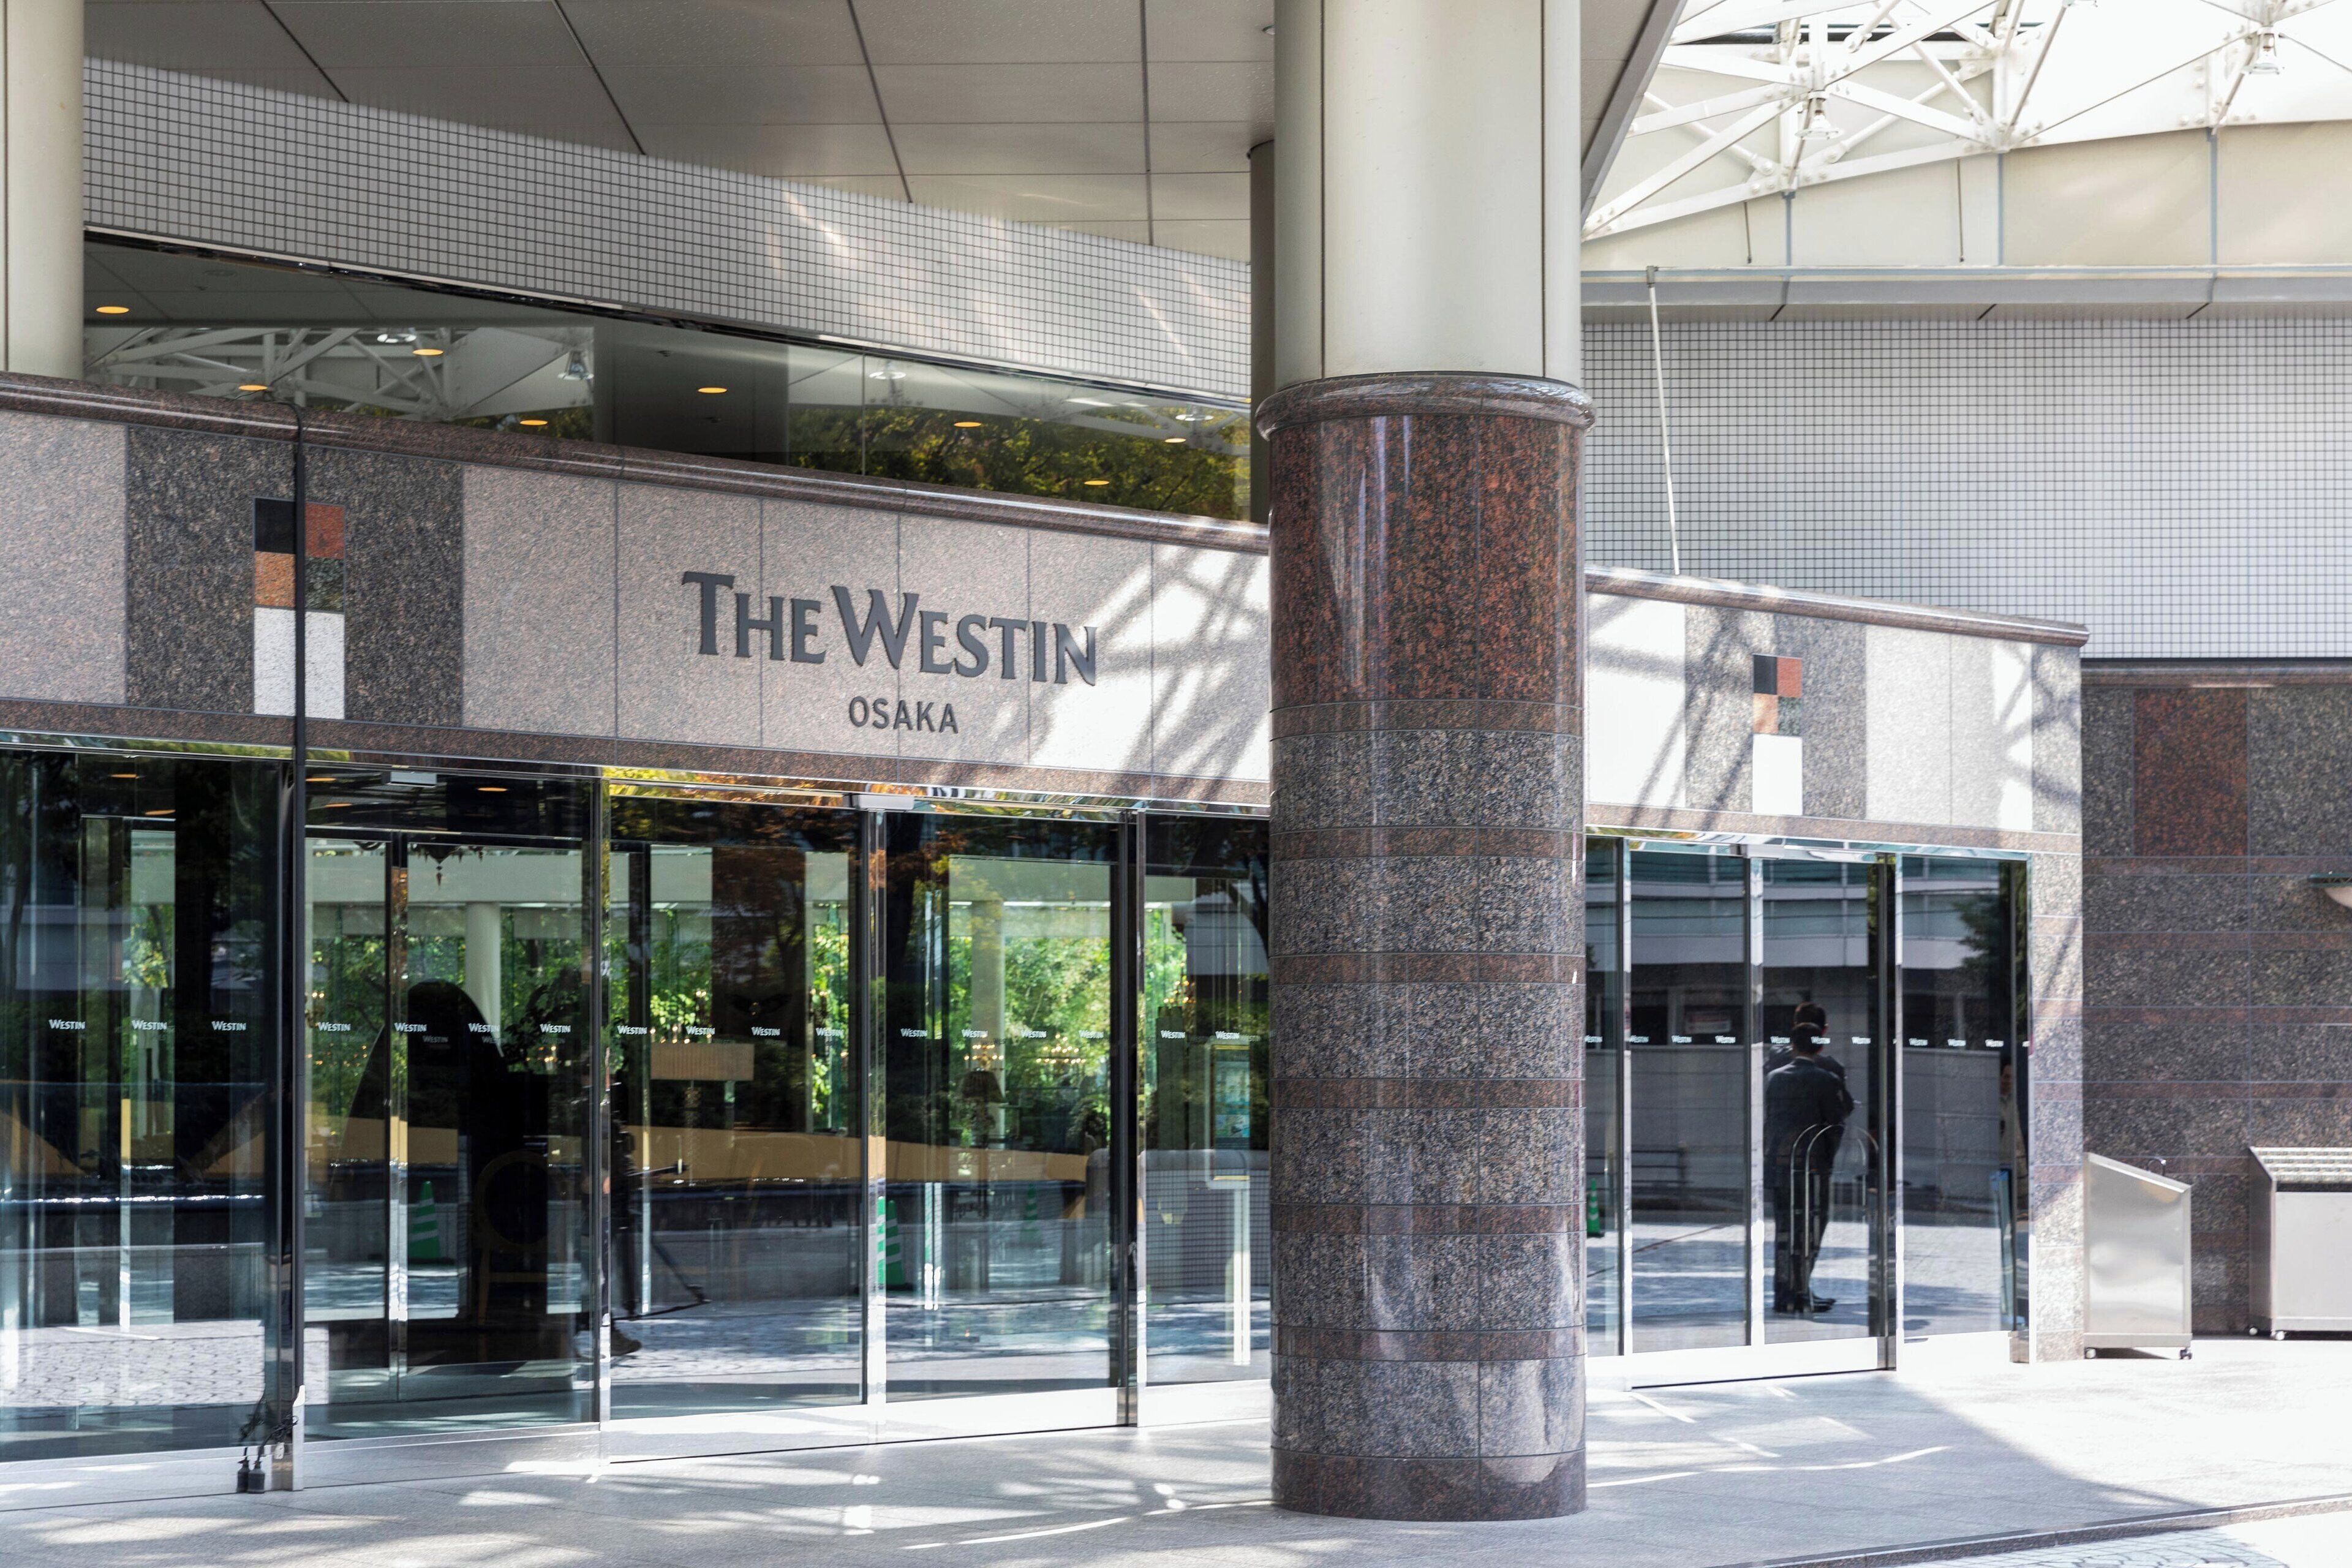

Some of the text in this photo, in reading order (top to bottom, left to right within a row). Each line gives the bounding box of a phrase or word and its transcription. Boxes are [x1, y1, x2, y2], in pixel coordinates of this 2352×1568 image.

[681, 570, 1098, 687] THE WESTIN
[848, 696, 959, 734] OSAKA
[48, 1019, 86, 1030] WESTIN
[131, 1020, 167, 1030] WESTIN
[211, 1021, 247, 1031] WESTIN
[318, 1022, 352, 1032] WESTIN
[394, 1022, 428, 1032] WESTIN
[540, 1023, 571, 1033] WESTIN
[617, 1025, 647, 1035] WESTIN
[685, 1026, 715, 1036] WESTIN
[751, 1027, 780, 1036] WESTIN
[900, 1028, 928, 1038] WESTIN
